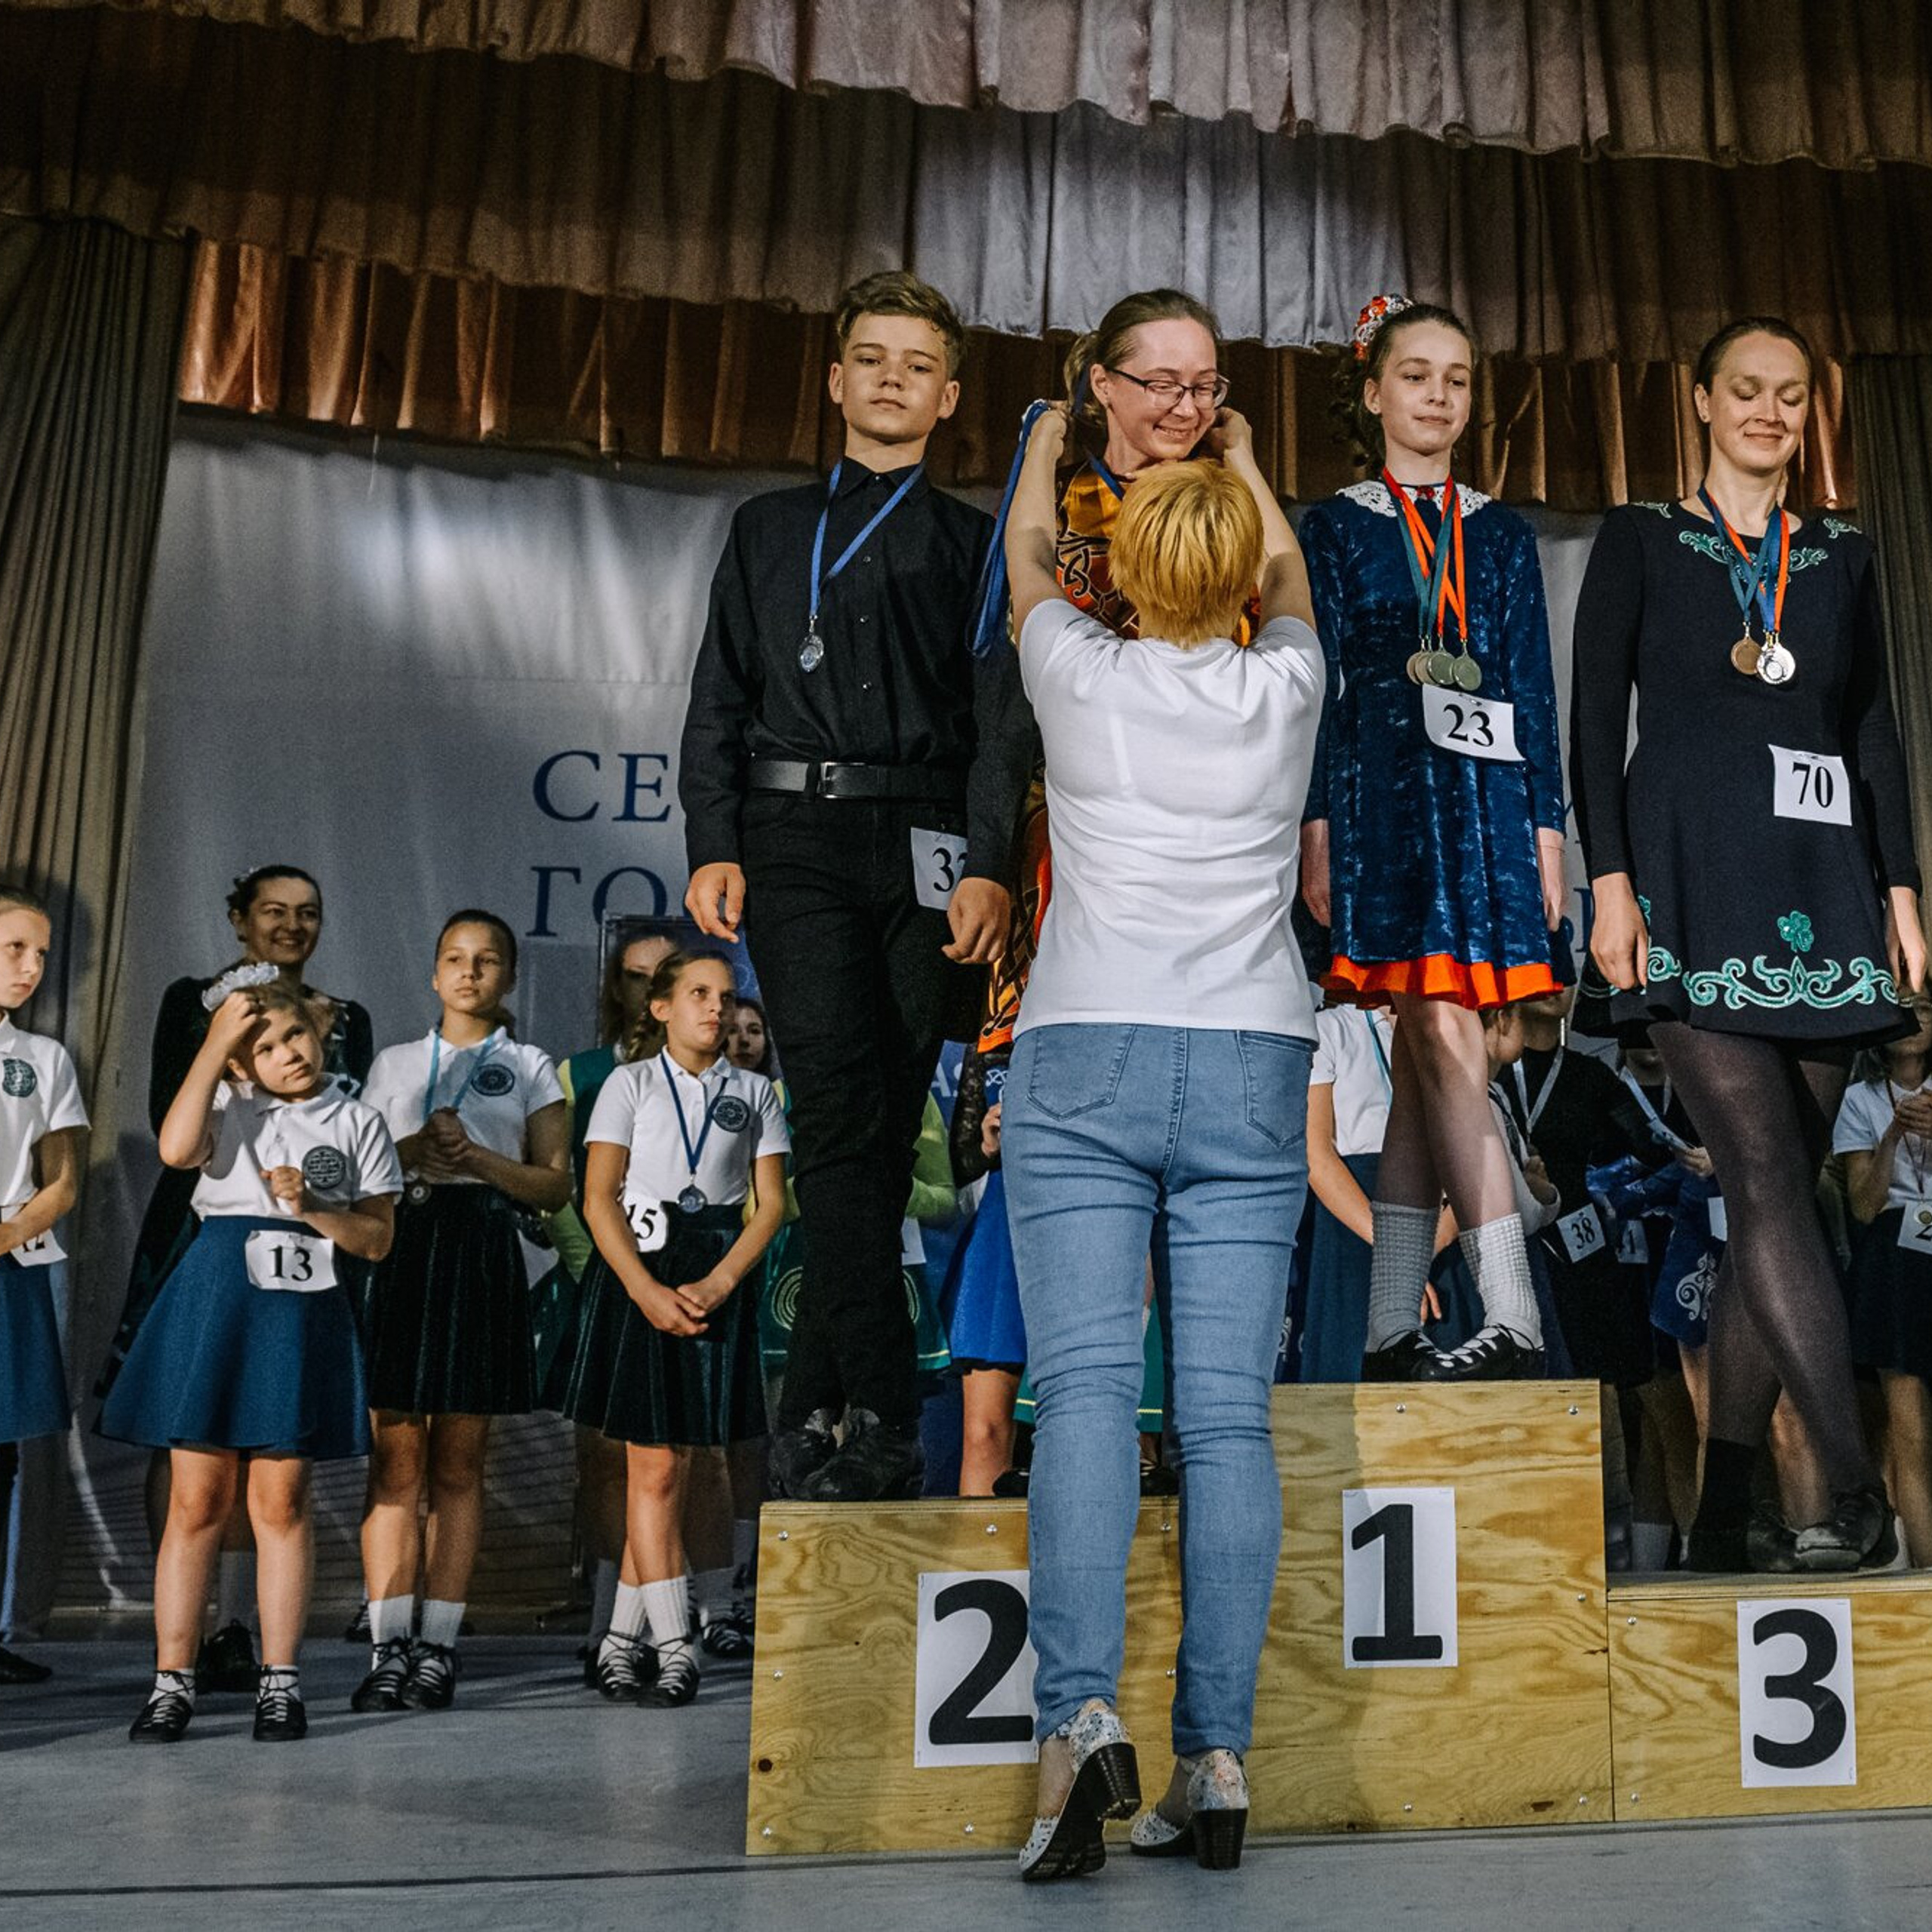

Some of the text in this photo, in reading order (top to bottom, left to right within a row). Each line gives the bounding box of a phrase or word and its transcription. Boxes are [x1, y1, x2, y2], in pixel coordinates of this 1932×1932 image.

[1443, 703, 1494, 747] 23
[533, 750, 671, 822] СЕ
[1792, 761, 1833, 808] 70
[526, 866, 691, 937] ГО
[627, 1204, 657, 1239] 15
[1571, 1217, 1595, 1250] 38
[268, 1244, 313, 1281] 13
[1352, 1503, 1443, 1661] 1
[928, 1578, 1034, 1745] 2
[1752, 1608, 1847, 1769] 3
